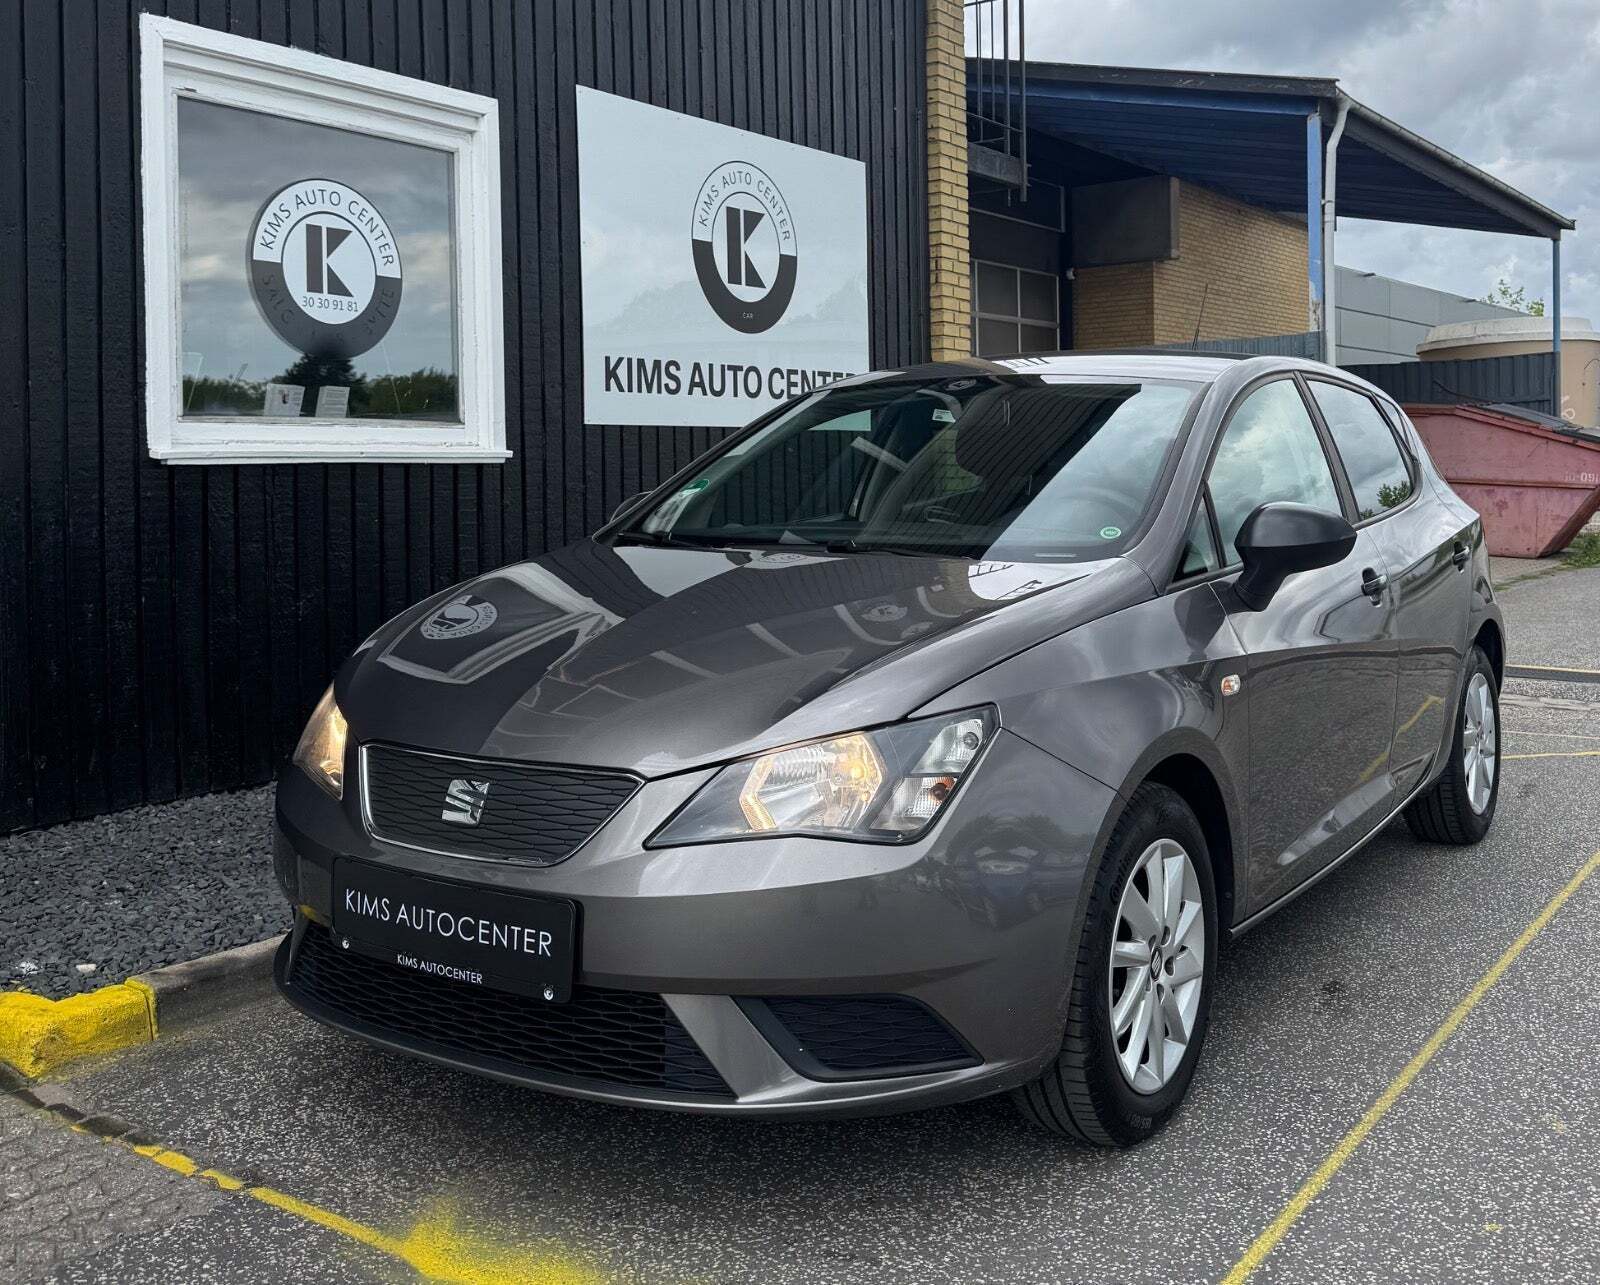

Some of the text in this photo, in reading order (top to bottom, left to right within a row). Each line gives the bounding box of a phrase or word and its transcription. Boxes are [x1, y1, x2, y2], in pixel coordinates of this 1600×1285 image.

[260, 189, 395, 267] KIMS AUTO CENTER
[699, 170, 791, 241] KIMS AUTO CENTER
[302, 295, 358, 312] 30 30 91 81
[604, 355, 856, 401] KIMS AUTO CENT
[345, 888, 552, 957] KIMS AUTOCENTER
[397, 953, 483, 984] KIMS AUTOCENTER
